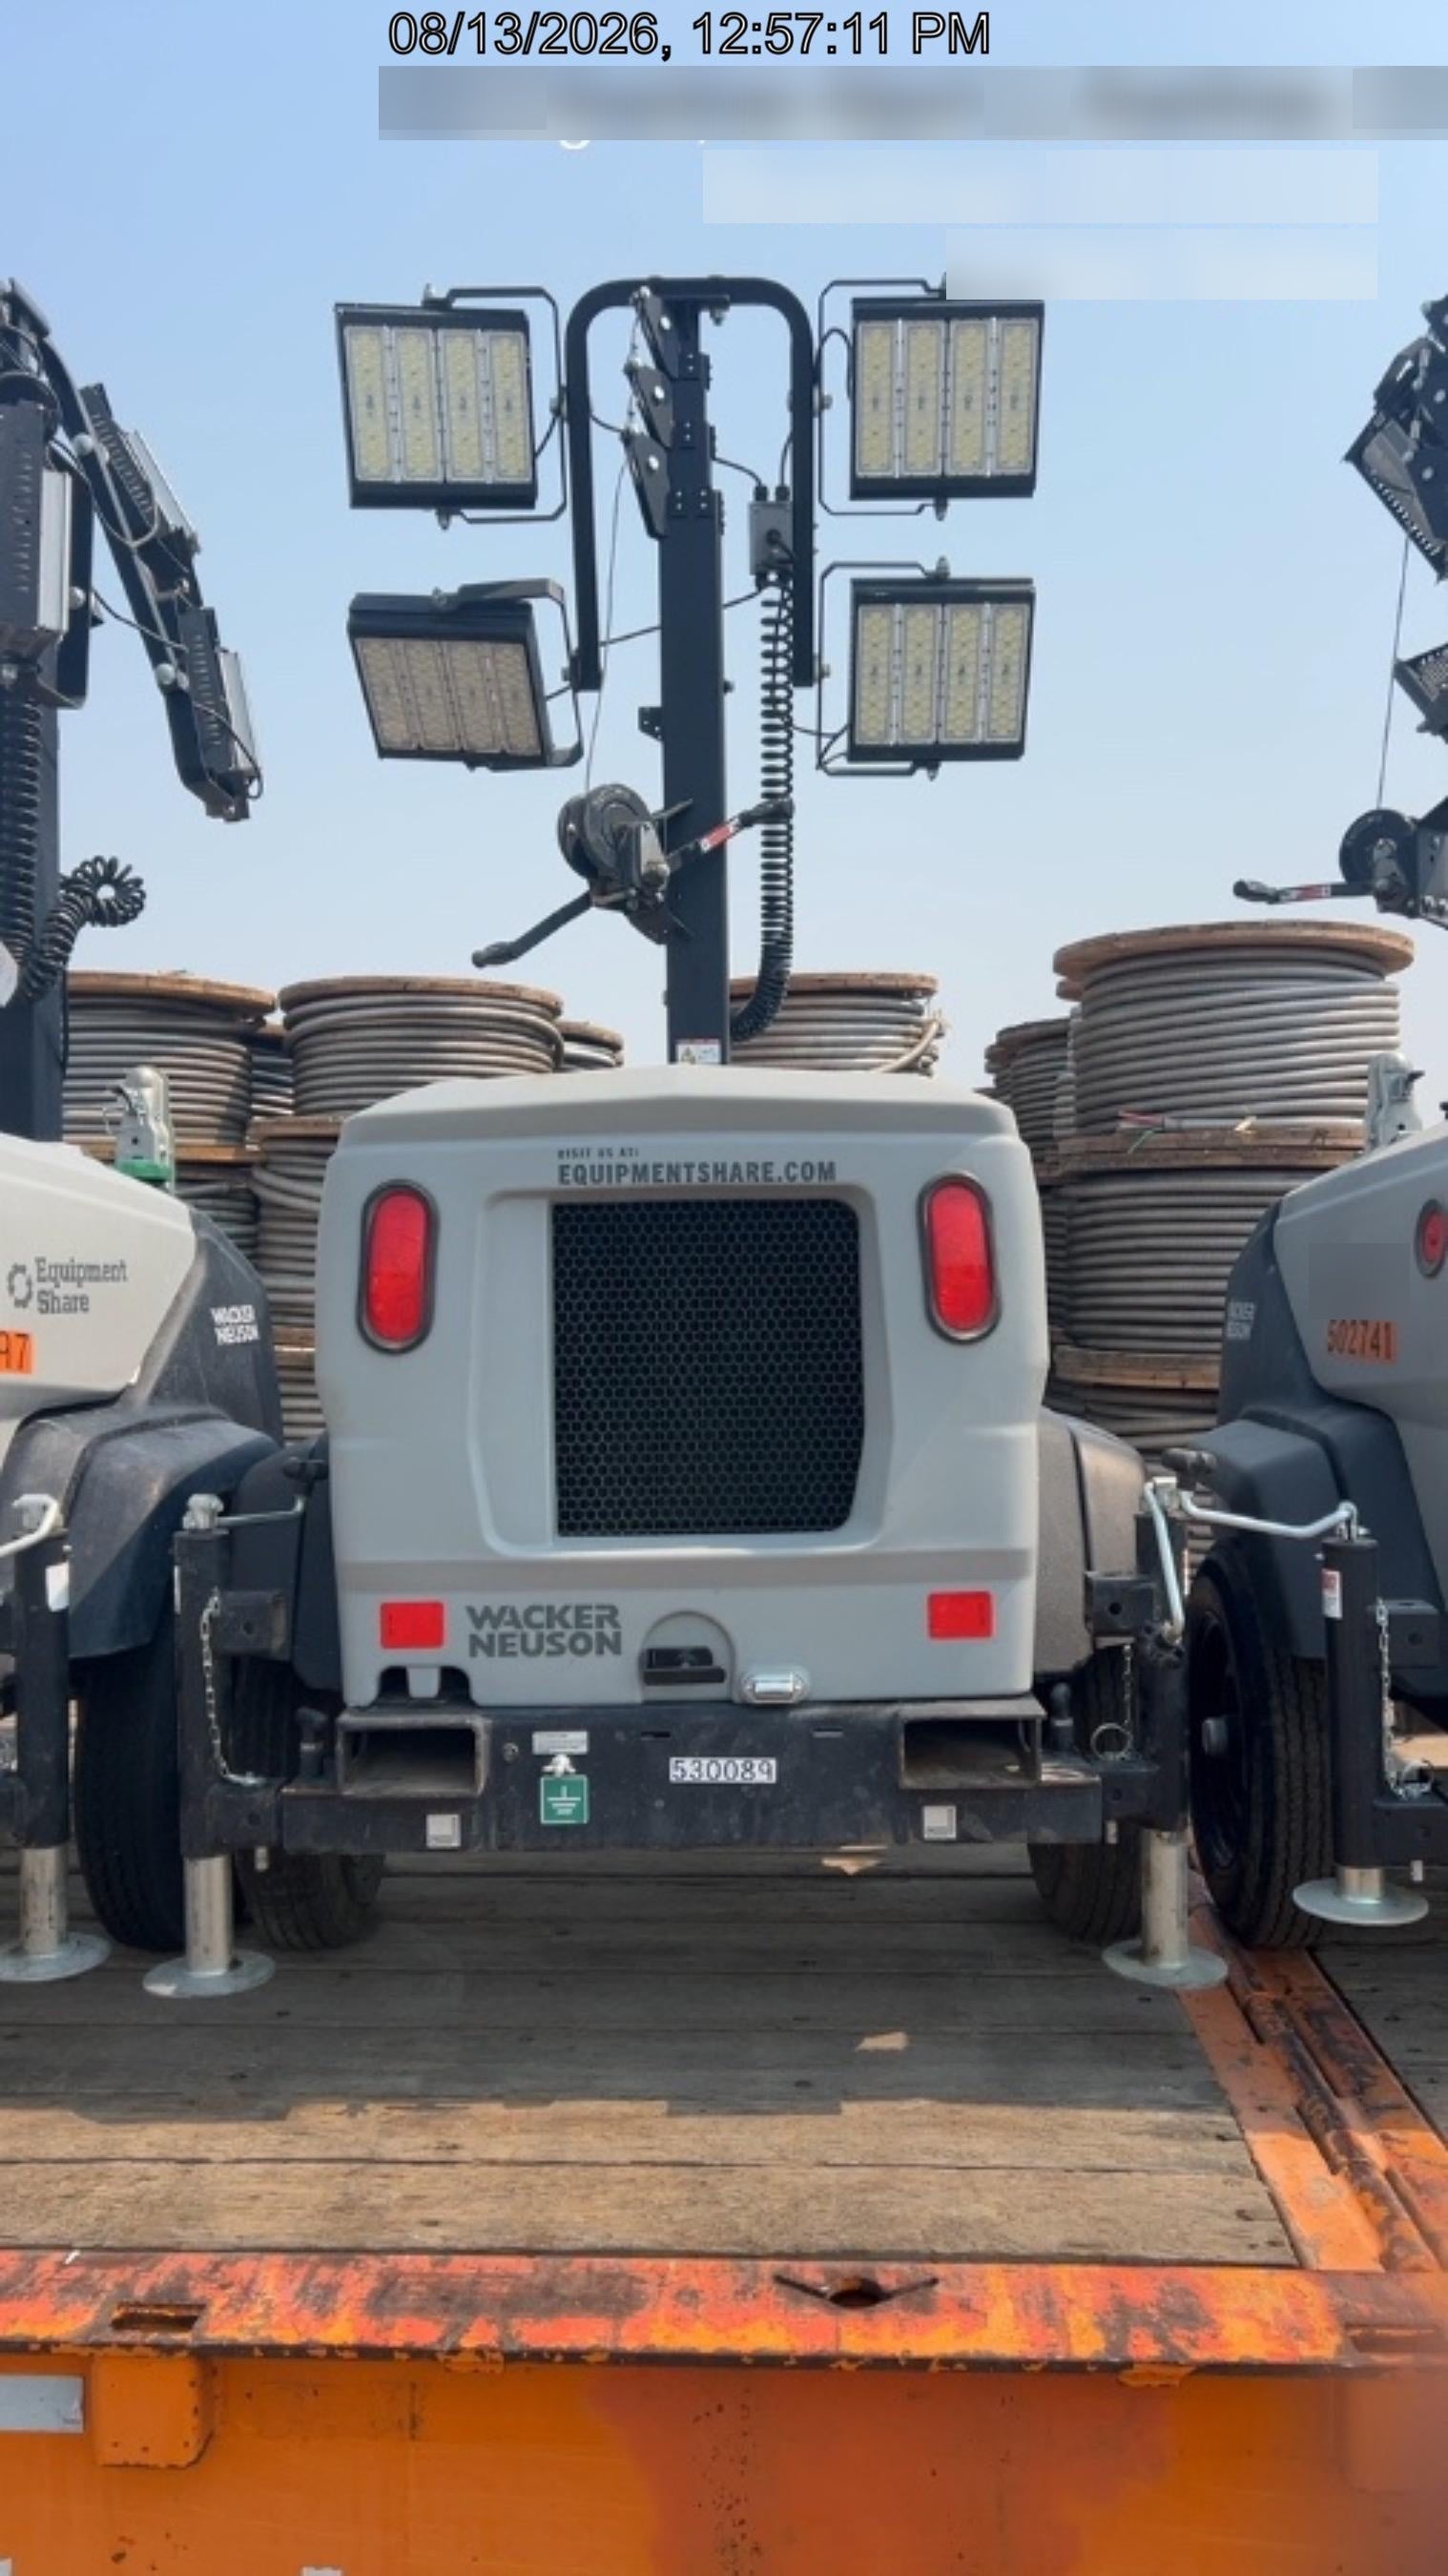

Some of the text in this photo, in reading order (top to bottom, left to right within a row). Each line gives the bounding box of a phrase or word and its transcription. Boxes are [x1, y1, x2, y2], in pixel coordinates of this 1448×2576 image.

[557, 1160, 838, 1186] EQUIPMENTSHARE.COM
[34, 1256, 129, 1289] Equipment
[36, 1289, 91, 1315] Share
[1327, 1319, 1393, 1361] 502741
[465, 1604, 622, 1631] WACKER
[468, 1631, 622, 1658] NEUSON
[672, 1759, 775, 1780] 530089
